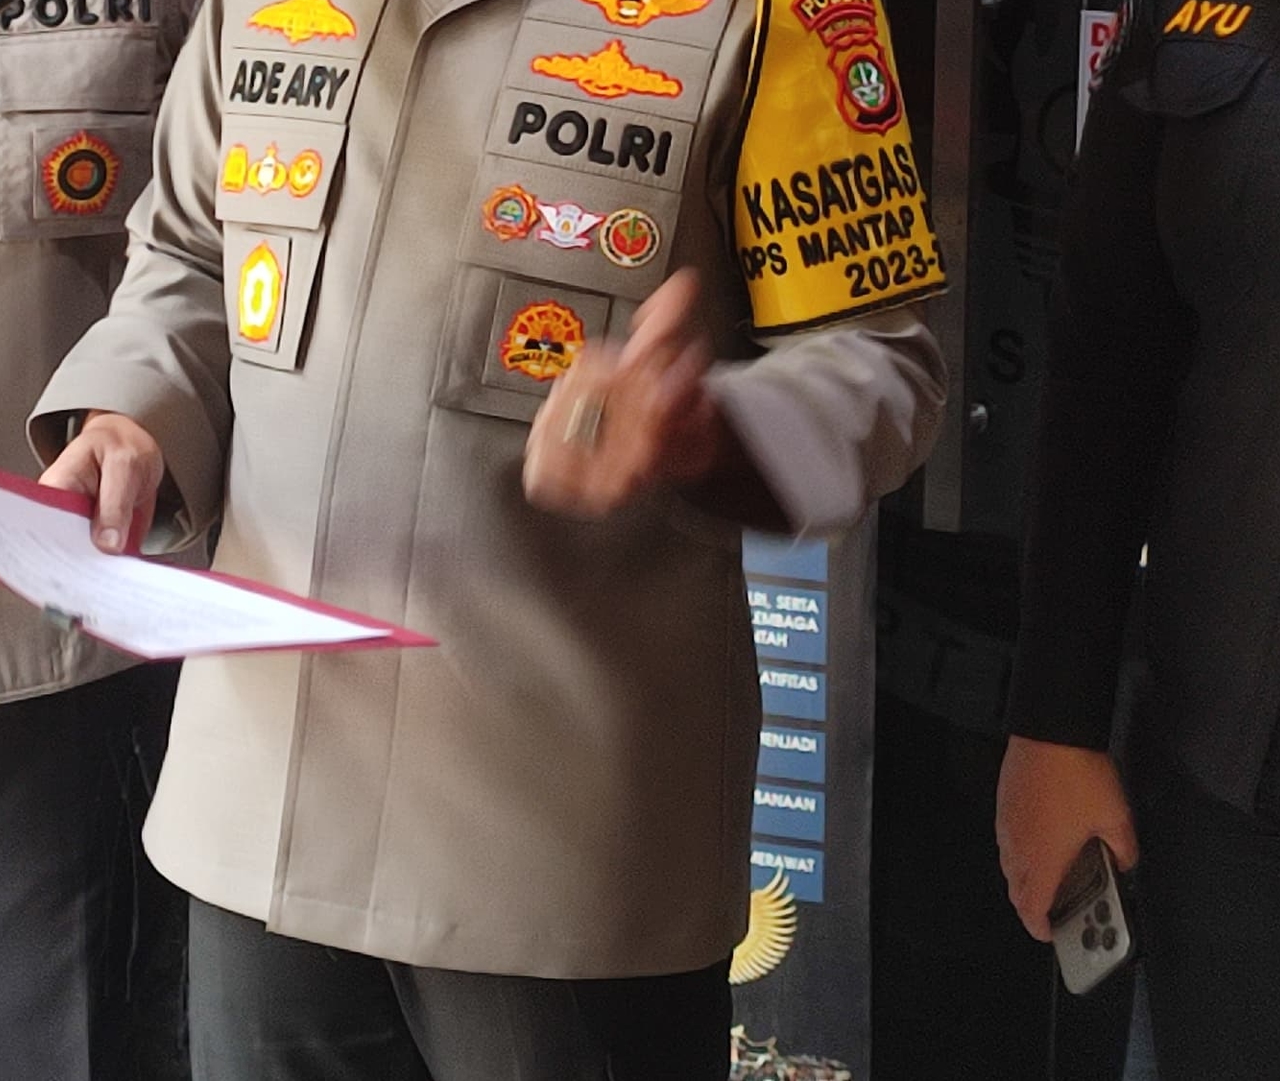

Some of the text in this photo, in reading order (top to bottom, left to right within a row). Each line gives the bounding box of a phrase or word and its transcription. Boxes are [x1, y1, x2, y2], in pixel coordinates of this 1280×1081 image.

[508, 102, 673, 176] POLRI
[742, 143, 918, 239] KASATGAS
[797, 205, 915, 269] MANTAP
[776, 594, 819, 615] SERTA
